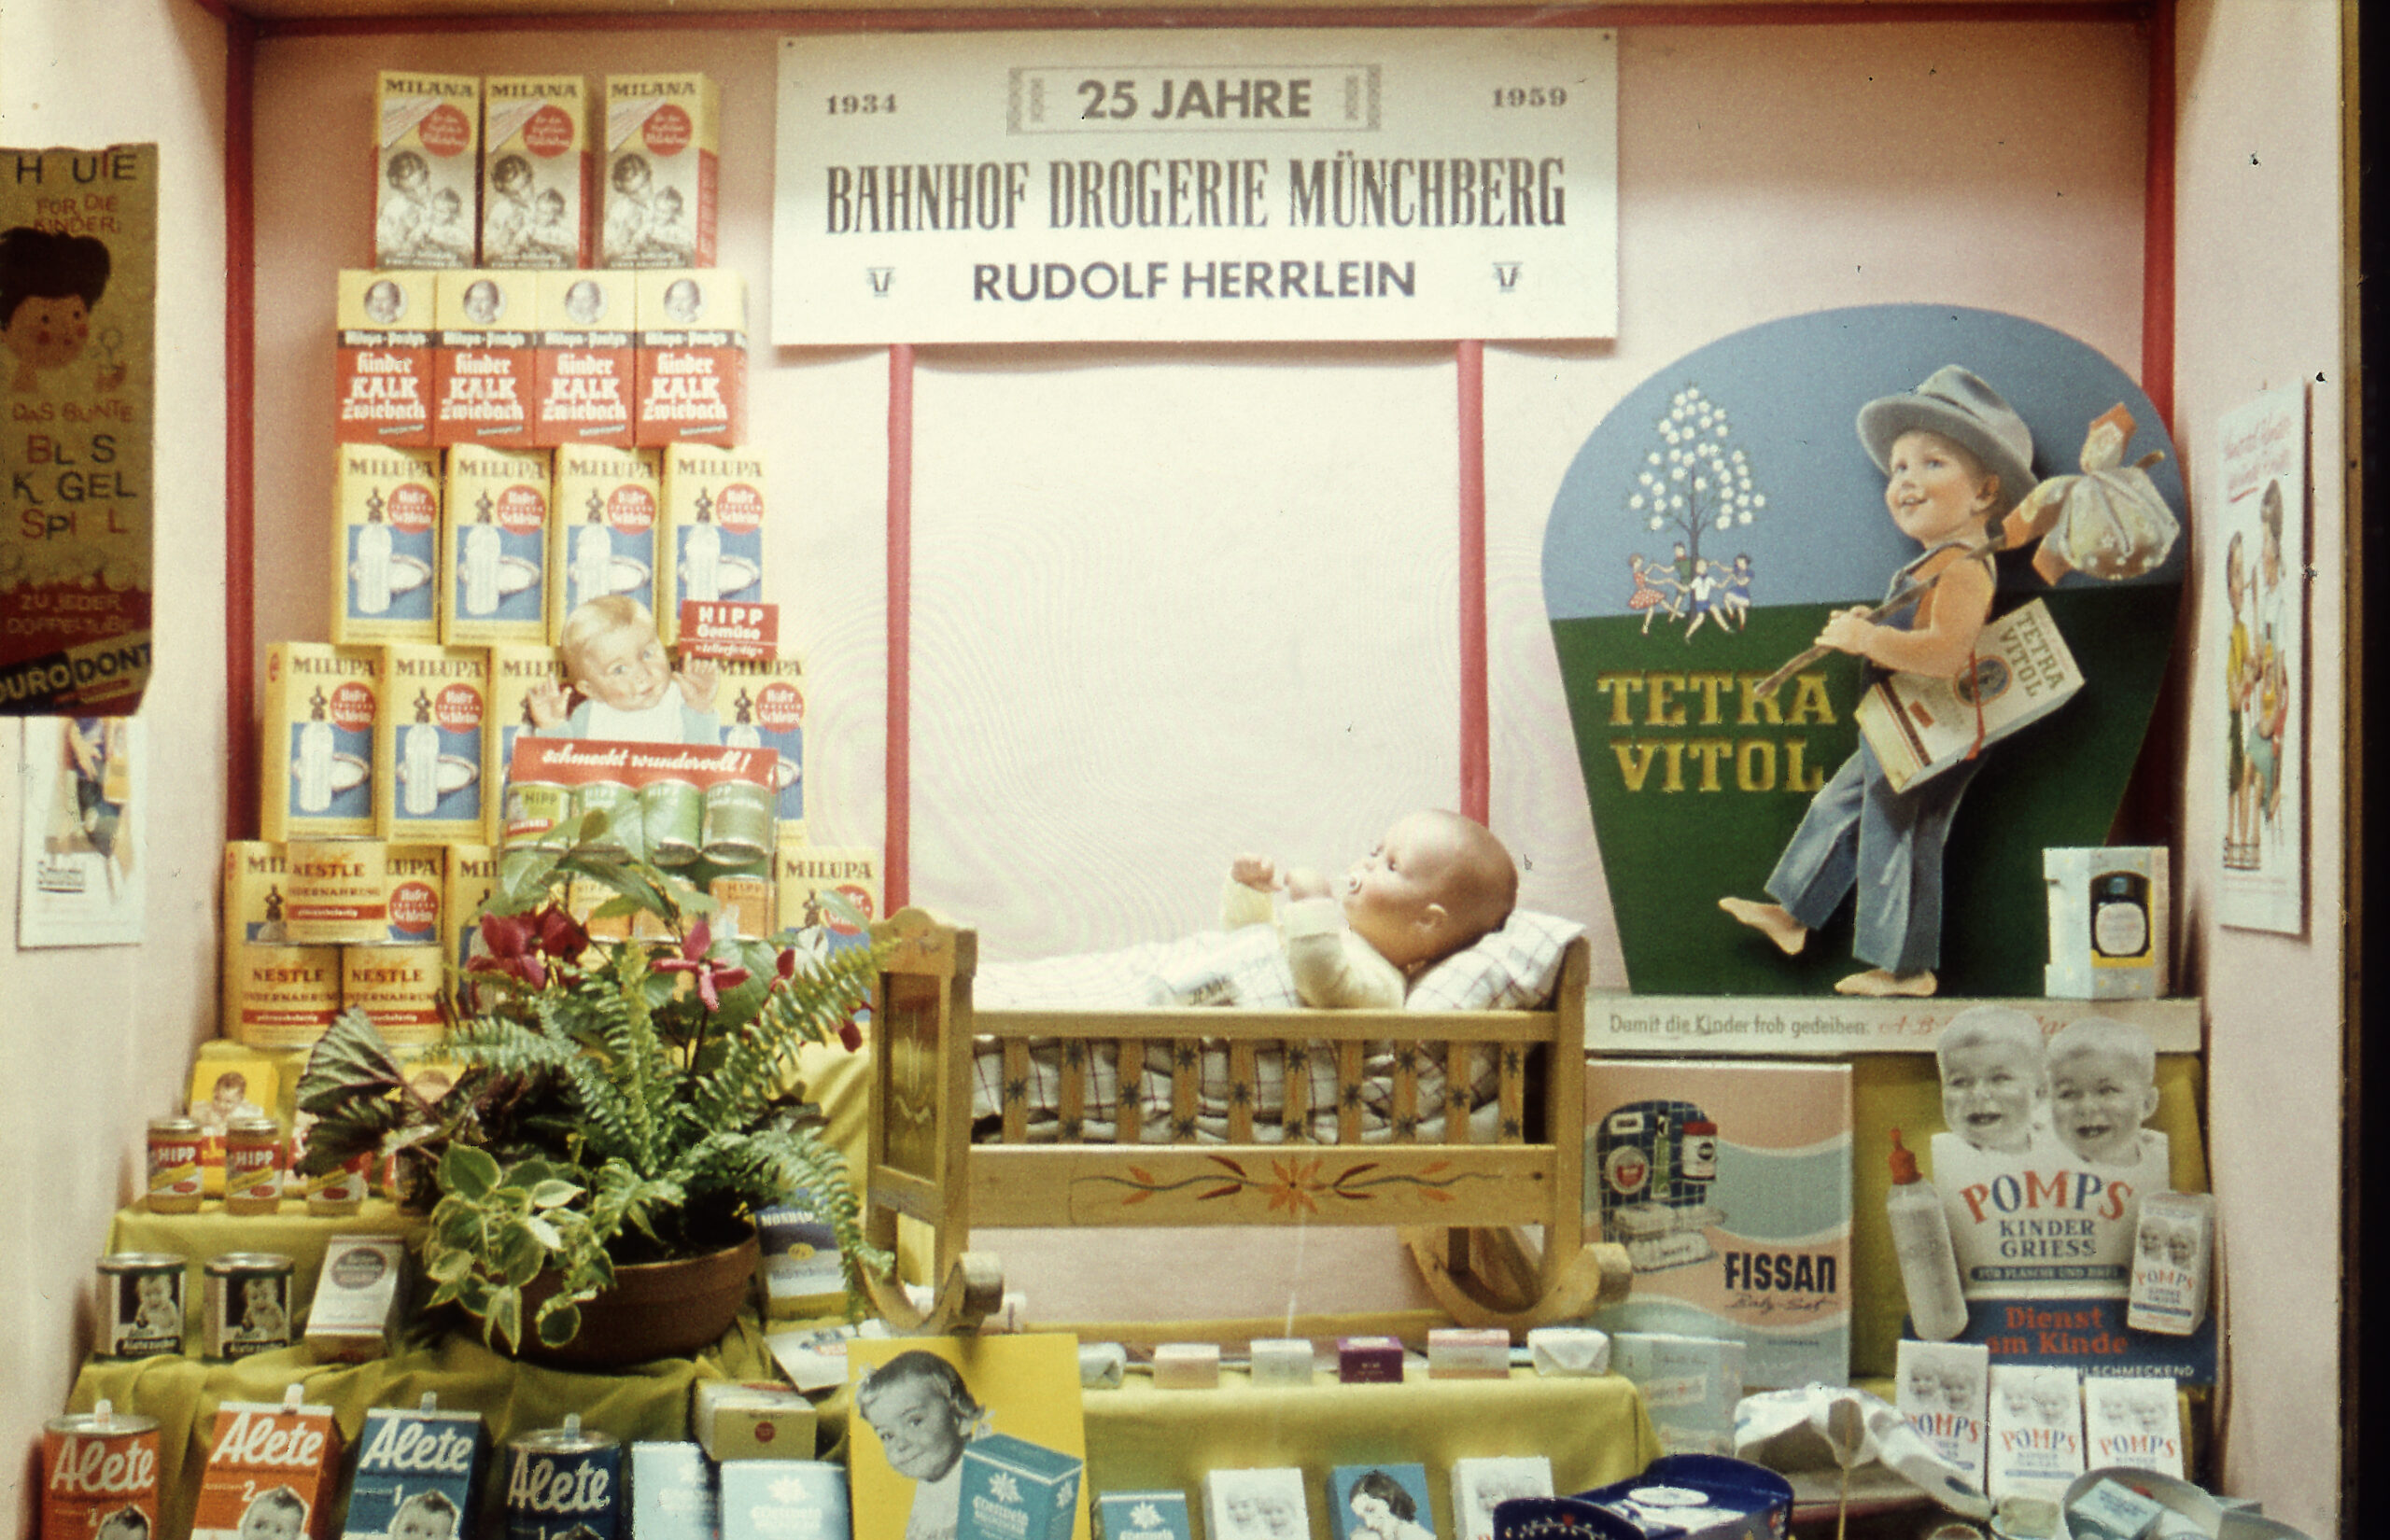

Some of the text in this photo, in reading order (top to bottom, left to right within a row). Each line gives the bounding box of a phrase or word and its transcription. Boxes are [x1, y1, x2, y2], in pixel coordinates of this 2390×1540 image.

[385, 77, 473, 97] MILANA
[491, 83, 578, 98] MILANA
[612, 81, 696, 97] MILANA
[1493, 87, 1568, 107] 1959
[826, 93, 898, 115] 1934
[1076, 79, 1312, 120] 25 JAHRE
[826, 149, 1567, 234] BAHNHOF DROGERIE MÜNCHBERG
[973, 260, 1415, 302] RUDOLF HERRLEIN
[351, 377, 418, 399] KALK
[450, 377, 517, 399] KALK
[551, 377, 619, 399] KALK
[652, 377, 720, 399] KALK
[342, 398, 426, 421] Zwieback
[440, 398, 524, 421] Zwieback
[542, 398, 627, 421] Zwieback
[641, 398, 728, 421] Zwieback
[348, 459, 433, 479] MILUPA
[457, 459, 546, 480] MILUPA
[568, 459, 655, 479] MILUPA
[677, 458, 763, 478] MILUPA
[698, 606, 764, 624] HIPP
[696, 623, 762, 640] Gemüse
[2016, 610, 2066, 691] TETRA
[292, 657, 374, 677] MILUPA
[395, 657, 485, 678] MILUPA
[1999, 626, 2043, 698] VITOL
[1596, 670, 1837, 726] TETRA
[541, 744, 752, 773] schmeckt wundervoll!
[1610, 736, 1824, 793] VITOL
[525, 790, 558, 805] HIPP
[785, 861, 873, 880] MILUPA
[1610, 1015, 1661, 1034] Damit
[1665, 1015, 1691, 1034] die
[1694, 1015, 1748, 1036] Kinder
[1753, 1015, 1786, 1034] froh
[158, 1146, 197, 1162] HIPP
[235, 1150, 274, 1166] HIPP
[1960, 1169, 2134, 1225] POMPS
[1999, 1219, 2096, 1238] KINDER
[2000, 1239, 2098, 1258] GRIESS
[2136, 1269, 2195, 1292] POMPS
[2004, 1307, 2104, 1330] Dienst
[1985, 1332, 2129, 1355] am Kinde
[210, 1411, 324, 1467] Alete
[359, 1417, 474, 1473] Alete
[2001, 1427, 2077, 1454] POMPS
[2099, 1434, 2176, 1459] POMPS
[49, 1435, 156, 1493] Alete
[241, 1479, 257, 1503] 2
[507, 1448, 612, 1513] Alete
[393, 1483, 403, 1506] 1
